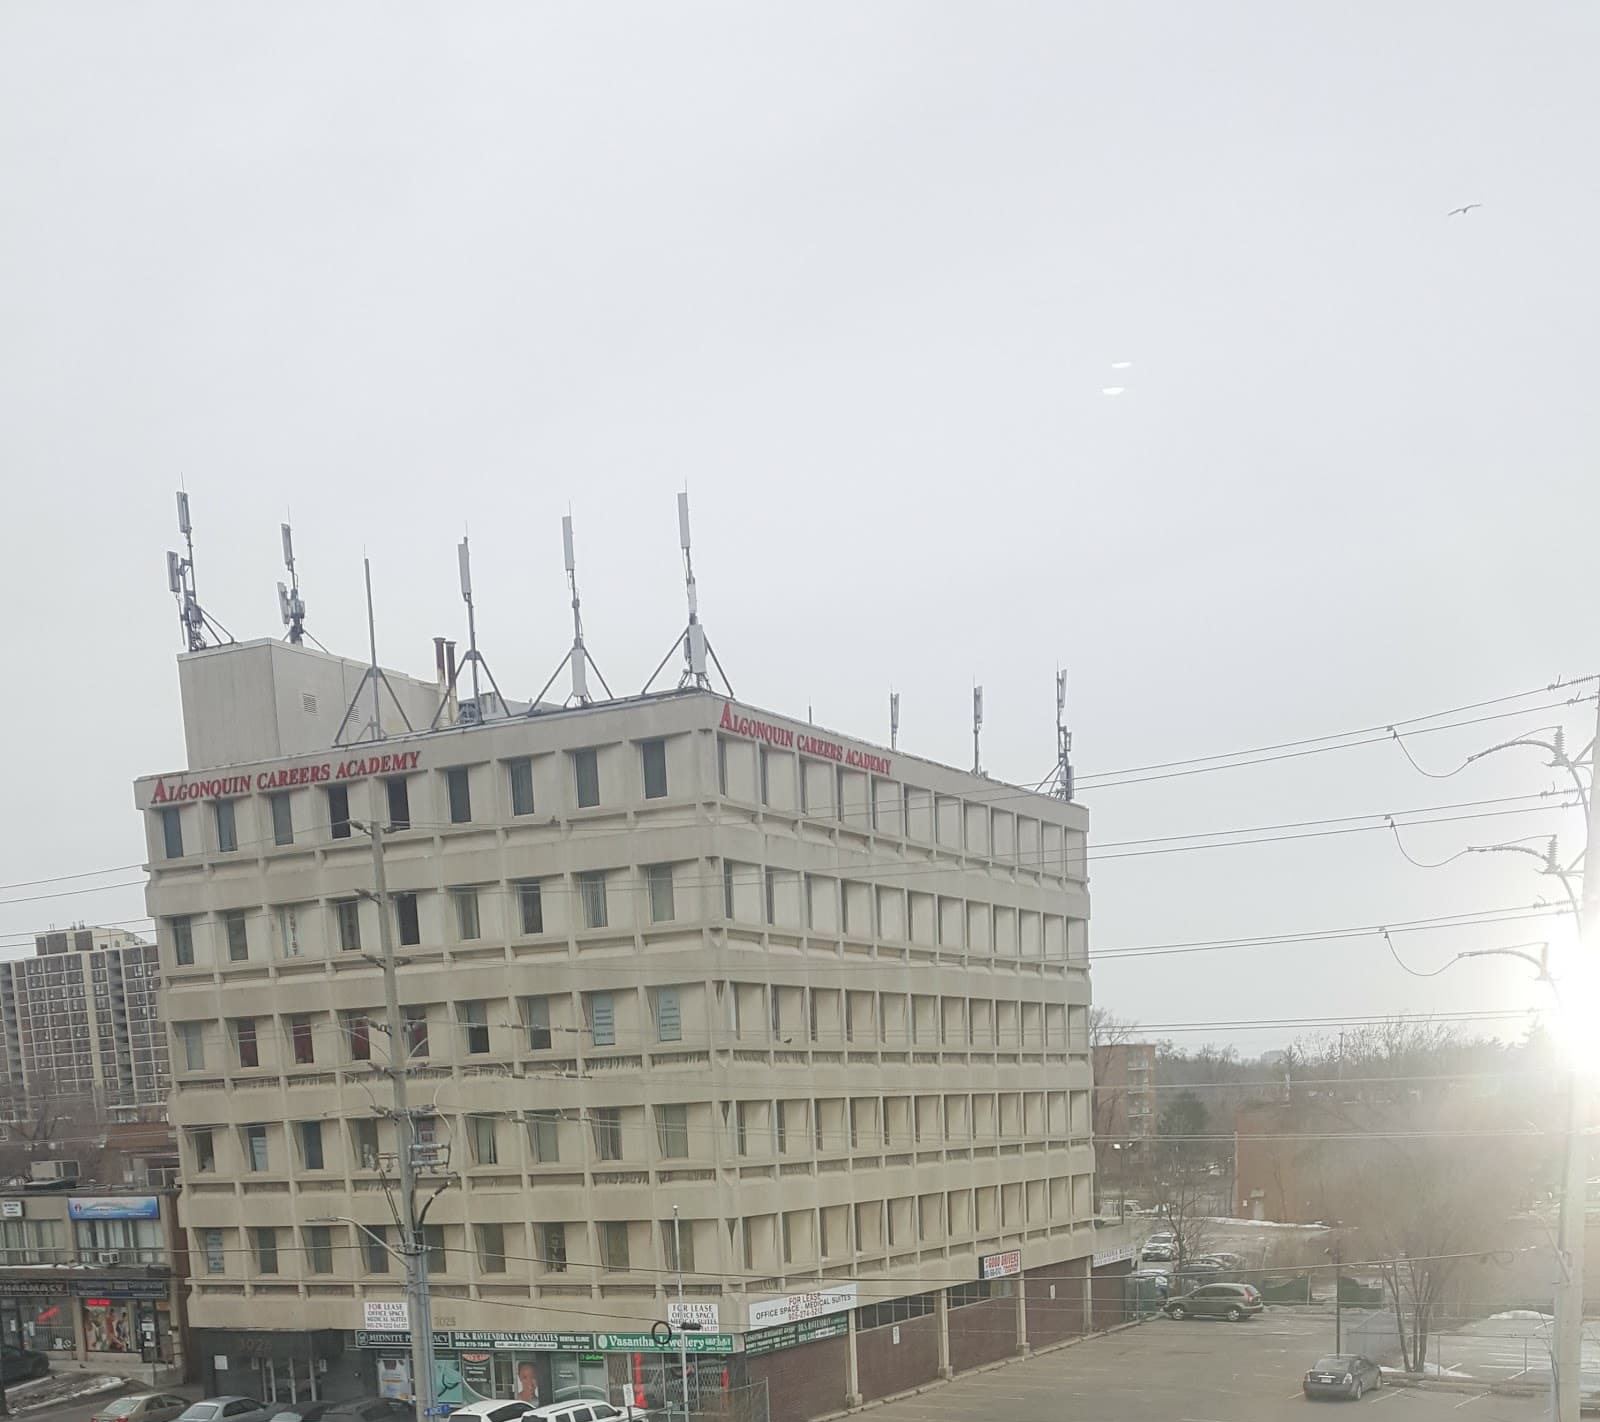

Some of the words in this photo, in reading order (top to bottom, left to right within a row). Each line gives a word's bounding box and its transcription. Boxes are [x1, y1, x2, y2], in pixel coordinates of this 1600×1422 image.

[720, 702, 794, 747] ALGONQUIN
[797, 734, 843, 763] CAREERS
[845, 751, 892, 776] ACADEMY
[151, 775, 252, 804] ALGONQUIN
[256, 764, 330, 790] CAREERS
[335, 751, 421, 779] ACADEMY
[691, 1304, 713, 1312] LEASE
[756, 1309, 778, 1320] OFFICE
[780, 1306, 799, 1315] SPACE
[804, 1298, 830, 1309] MEDICAL
[832, 1294, 851, 1304] SUITES
[609, 1335, 654, 1347] Vasantha
[657, 1336, 705, 1349] Jwelery
